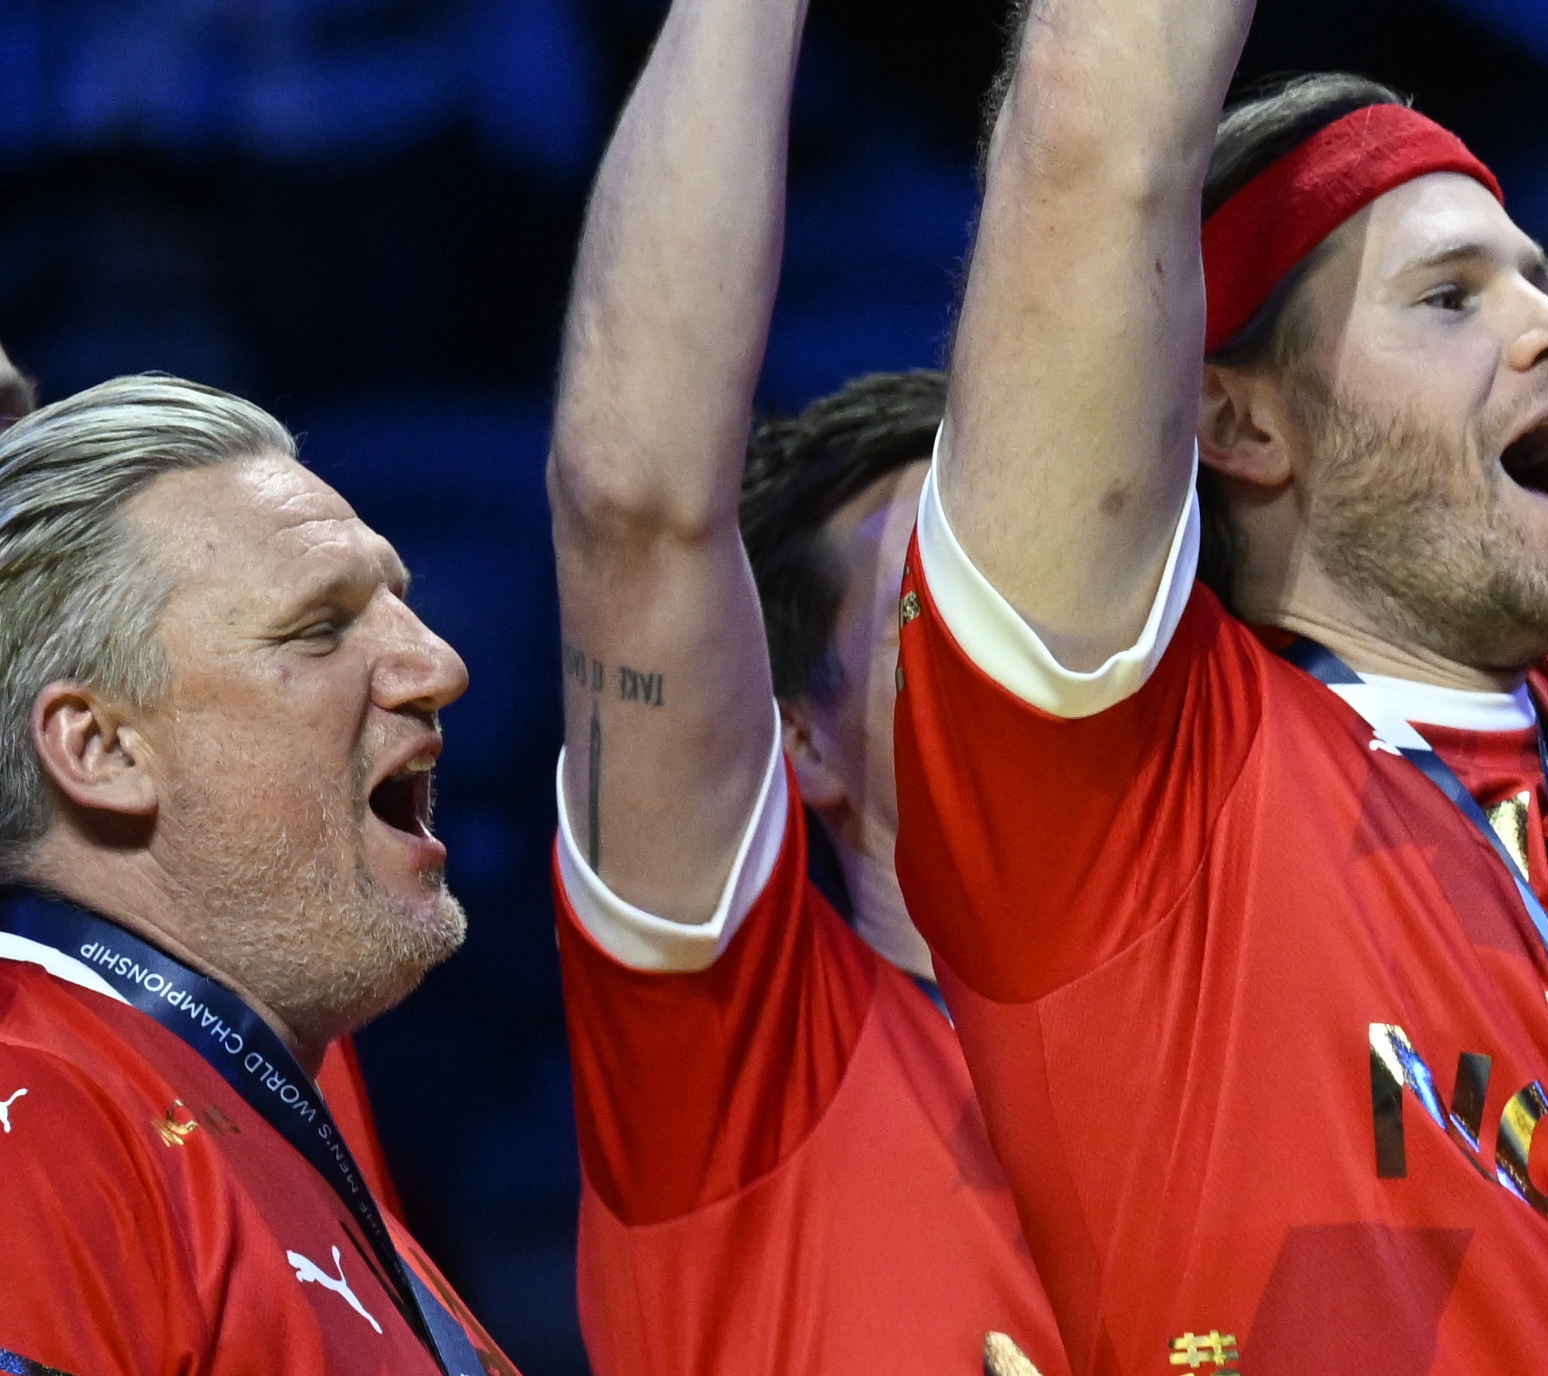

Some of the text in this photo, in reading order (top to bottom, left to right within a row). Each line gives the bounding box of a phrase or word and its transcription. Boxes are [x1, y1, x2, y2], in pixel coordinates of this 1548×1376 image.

[80, 941, 244, 1055] CHAMPIONSHIP
[243, 1051, 317, 1123] WORLD
[317, 1123, 360, 1195] MEN'S
